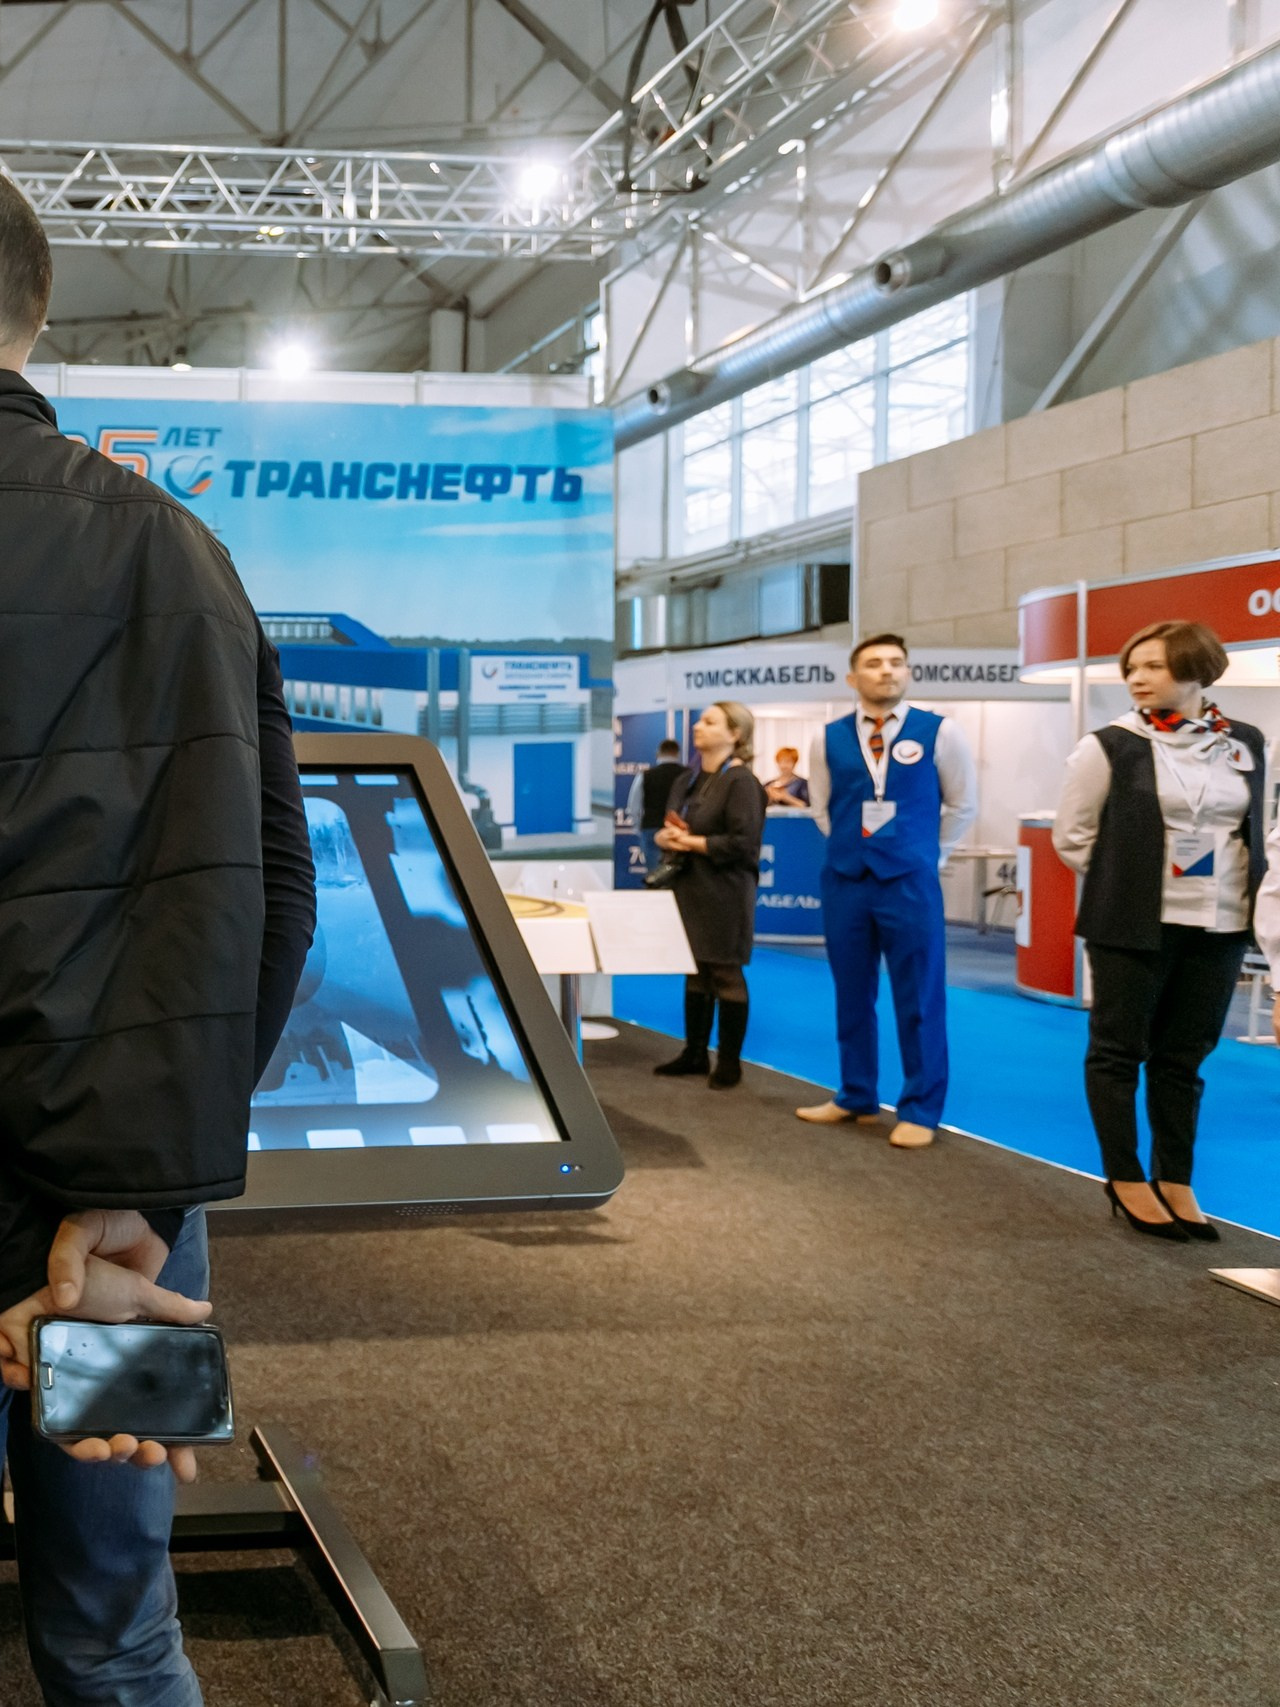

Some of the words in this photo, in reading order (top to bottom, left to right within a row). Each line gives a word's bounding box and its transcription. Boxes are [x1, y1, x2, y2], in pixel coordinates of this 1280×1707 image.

[162, 426, 222, 447] ЛЕТ
[223, 460, 584, 502] ТРАНСНЕФТЬ
[684, 662, 837, 690] ТОМСККАБЕЛЬ
[907, 663, 1020, 683] ОМСККАБЕЛ
